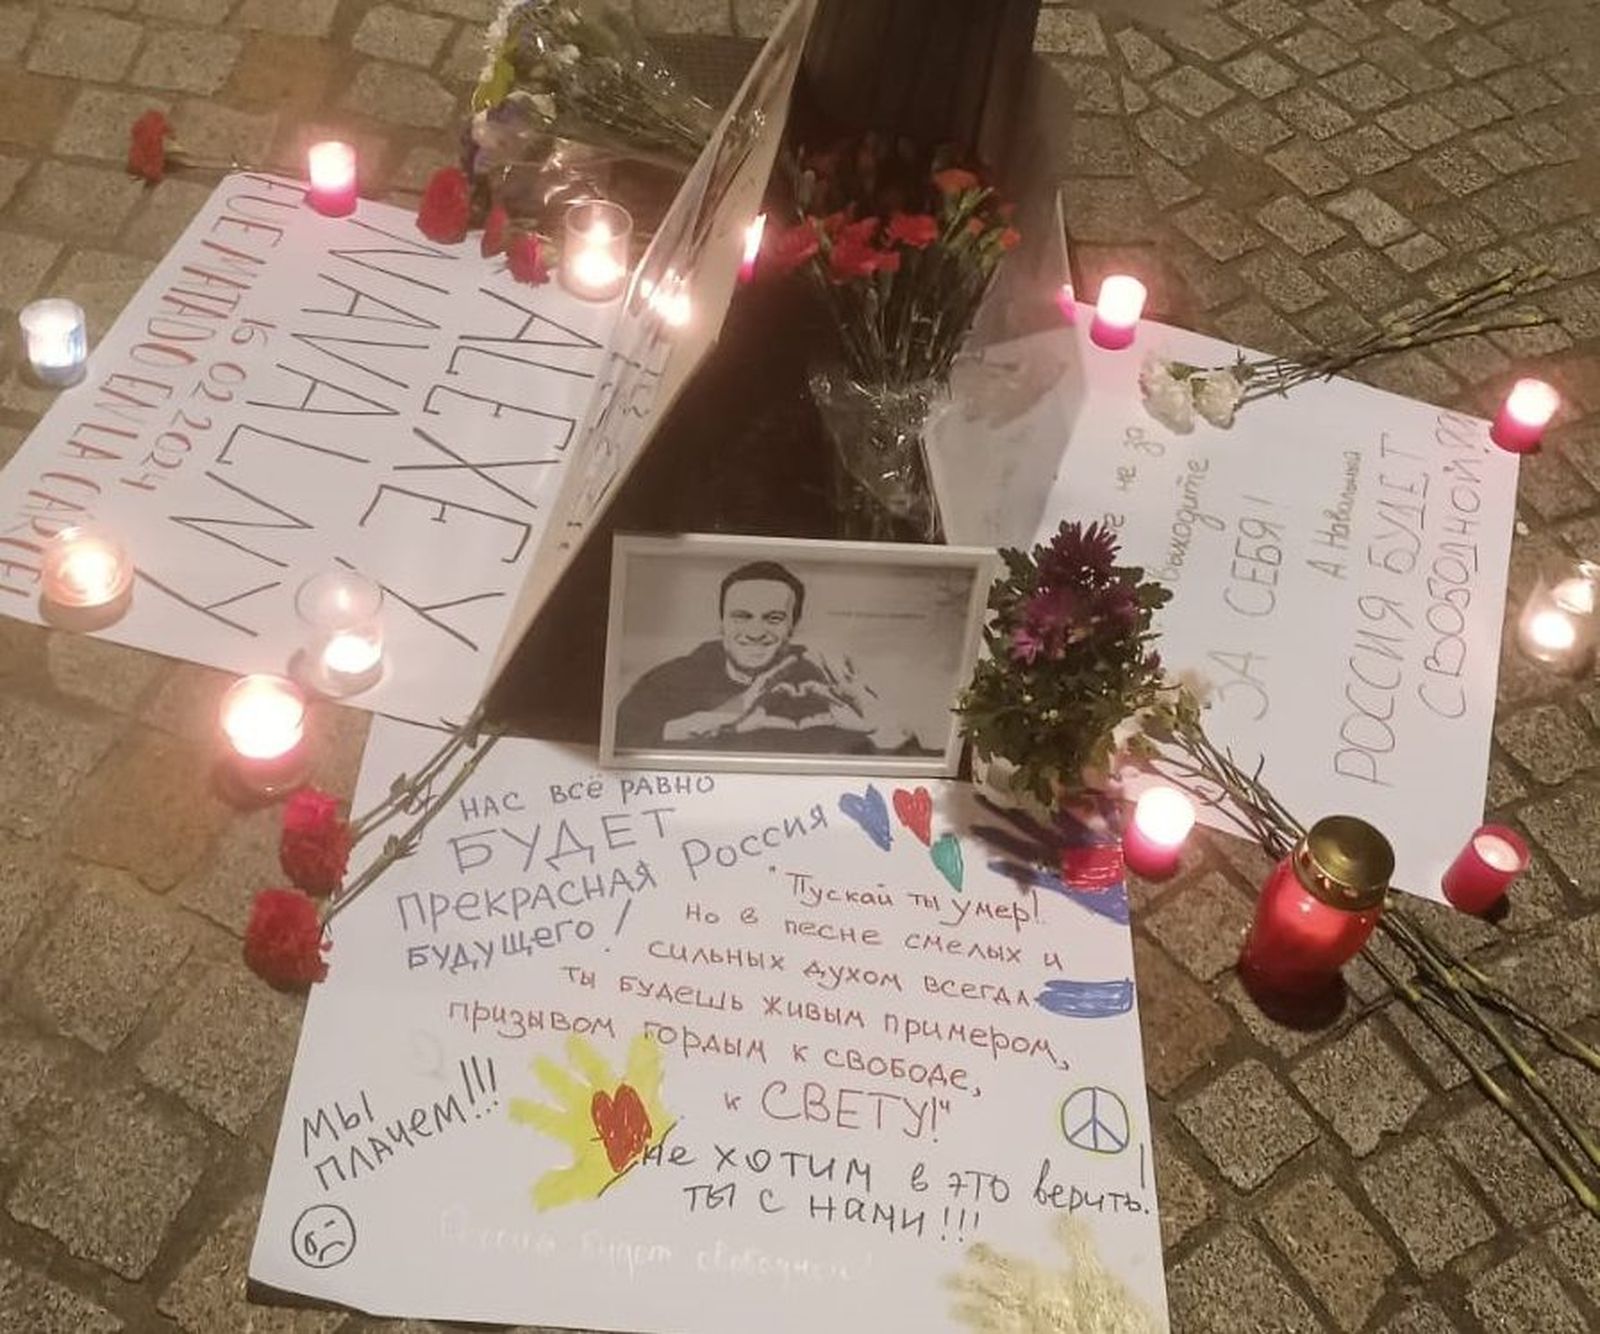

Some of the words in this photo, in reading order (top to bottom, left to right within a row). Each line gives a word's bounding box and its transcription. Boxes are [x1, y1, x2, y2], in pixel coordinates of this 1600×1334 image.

[119, 408, 212, 491] 2024
[133, 219, 459, 637] NAVALNY
[335, 288, 604, 651] ALEXEY
[1367, 432, 1429, 575] БУДЕТ
[1333, 595, 1416, 788] РОССИЯ
[447, 807, 676, 874] БУДЕТ
[459, 792, 525, 822] НАС
